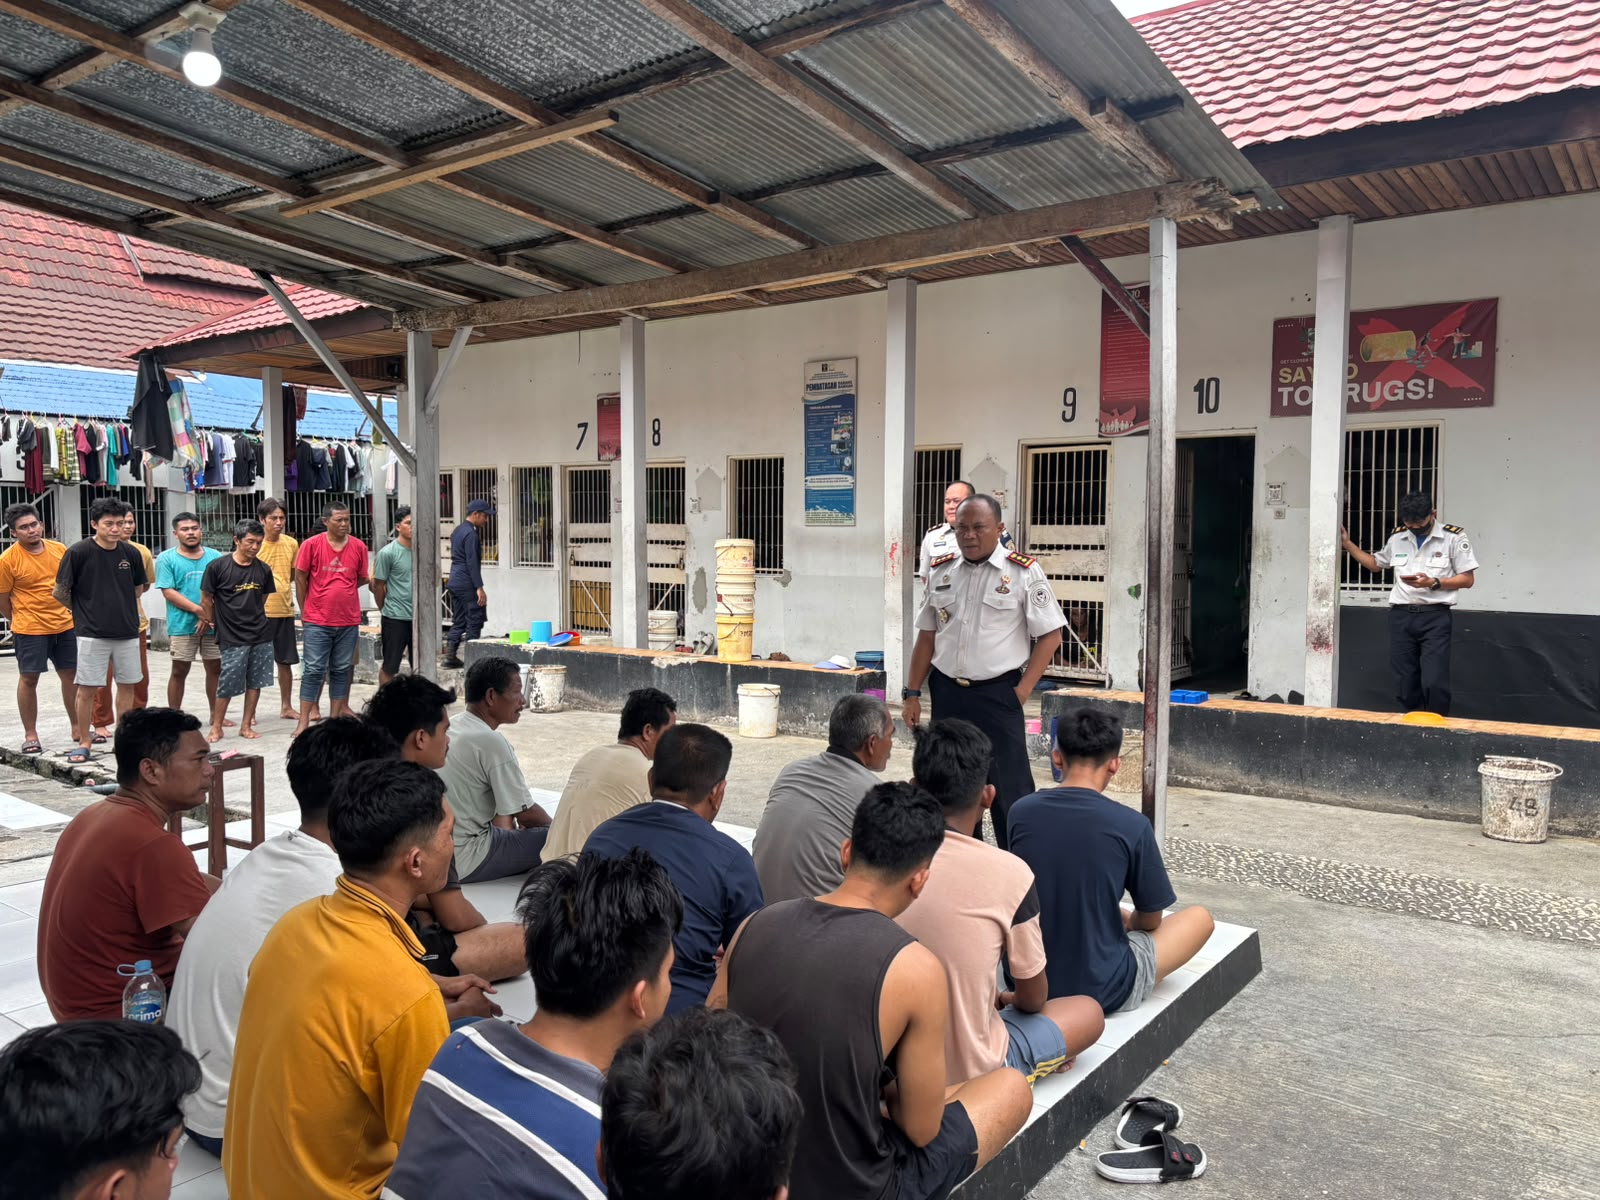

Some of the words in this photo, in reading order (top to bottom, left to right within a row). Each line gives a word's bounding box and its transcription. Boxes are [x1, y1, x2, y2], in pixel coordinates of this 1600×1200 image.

[1062, 387, 1077, 423] 9
[1193, 377, 1220, 414] 10
[1277, 385, 1313, 407] TO
[1347, 378, 1434, 403] RUGS!
[576, 422, 589, 450] 7
[652, 418, 661, 447] 8
